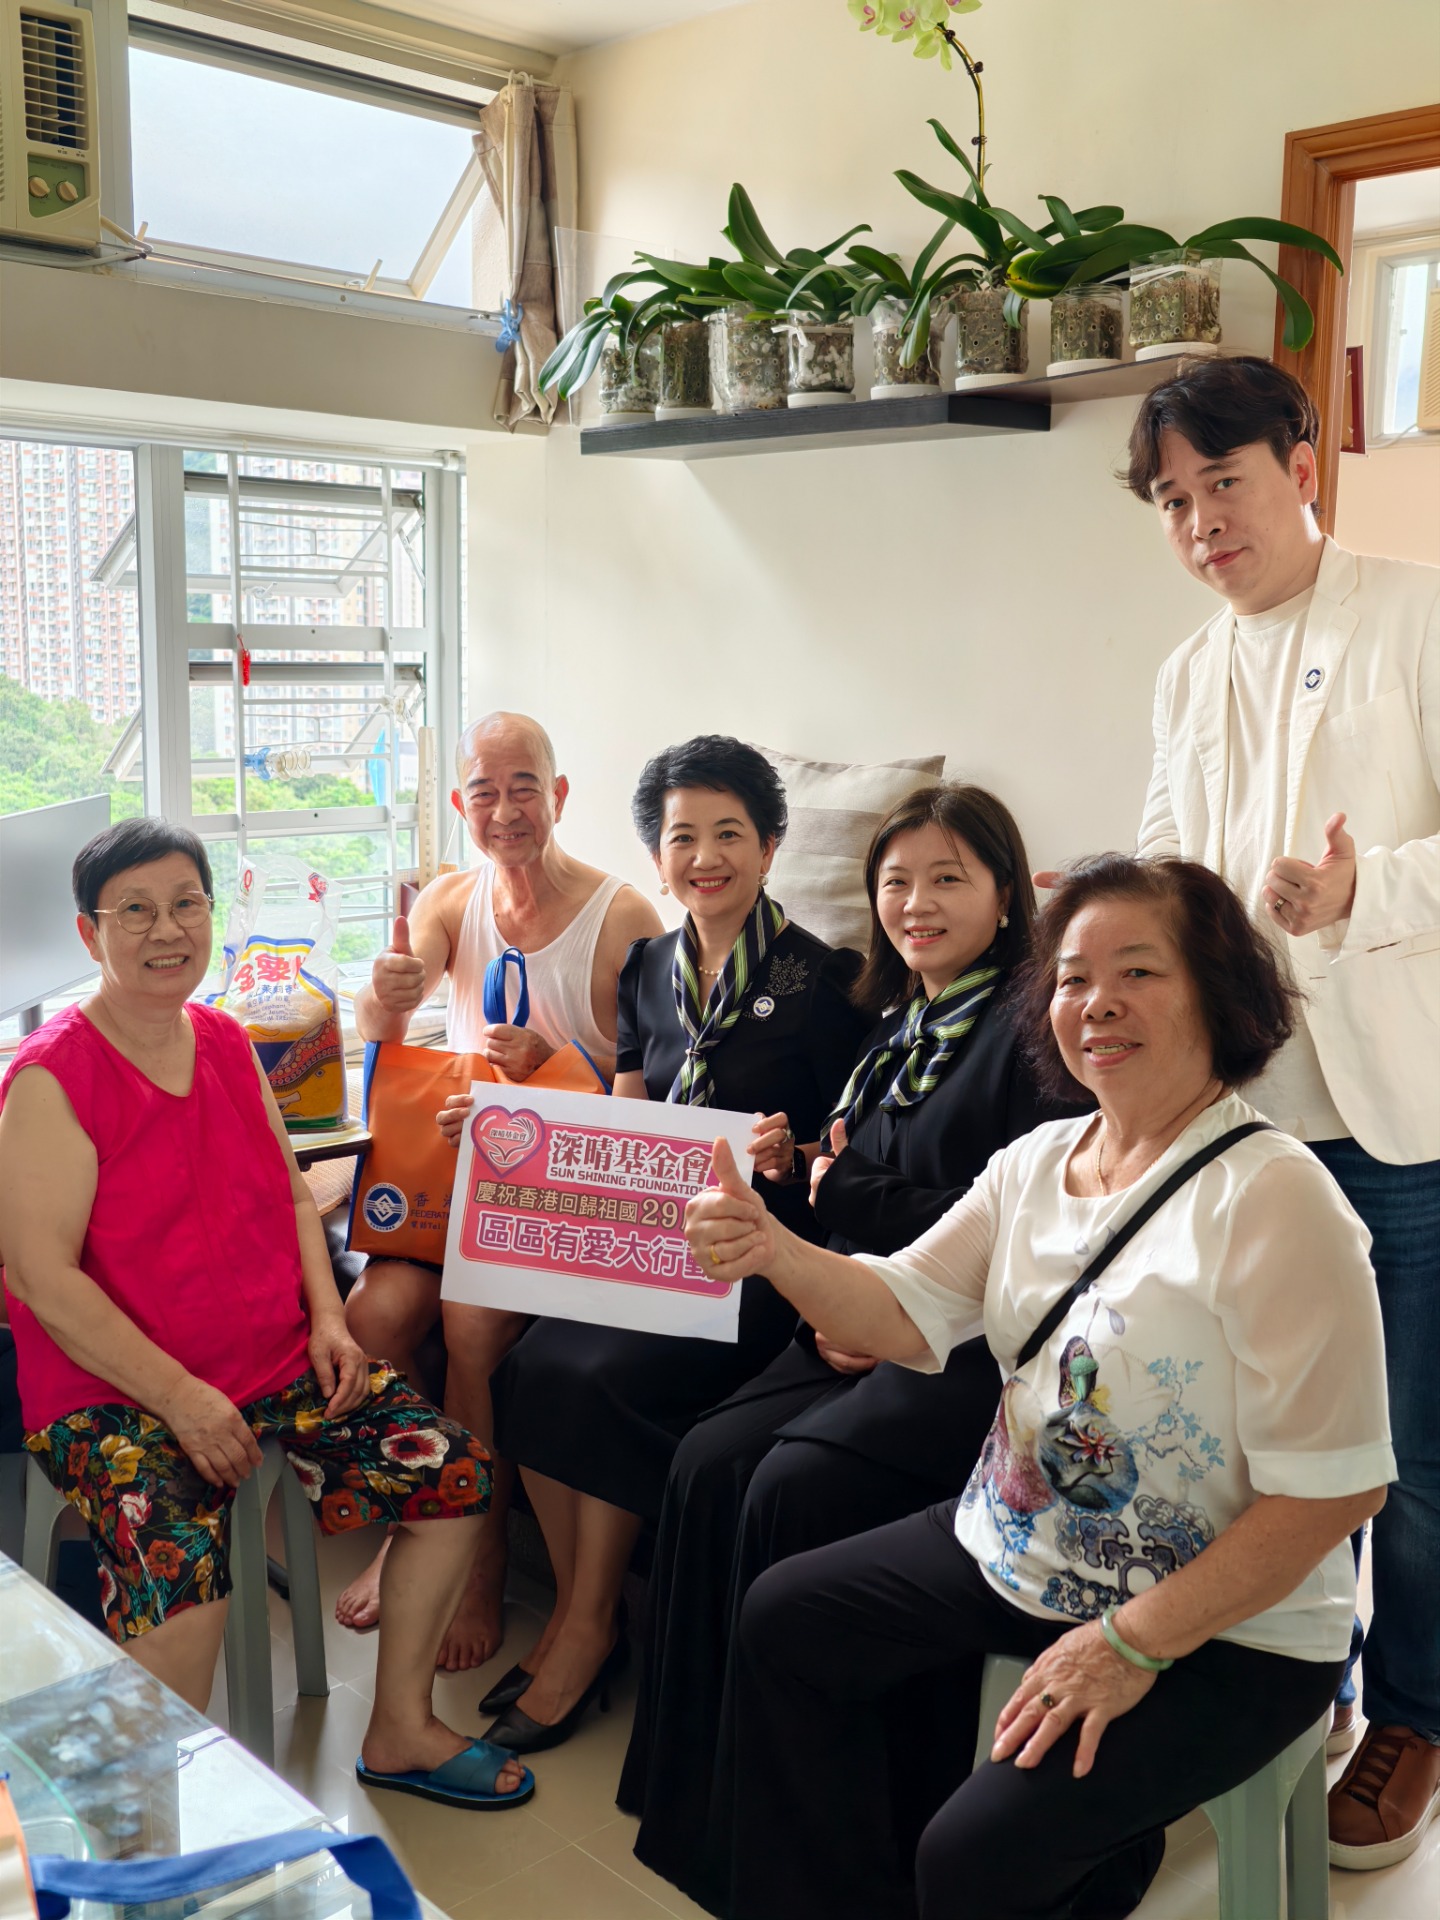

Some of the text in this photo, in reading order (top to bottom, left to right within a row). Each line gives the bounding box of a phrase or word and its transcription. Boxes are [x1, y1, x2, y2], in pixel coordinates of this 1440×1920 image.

[550, 1167, 575, 1179] SUN
[577, 1170, 627, 1186] SHINING
[475, 1181, 687, 1230] 慶祝香港回歸祖國29
